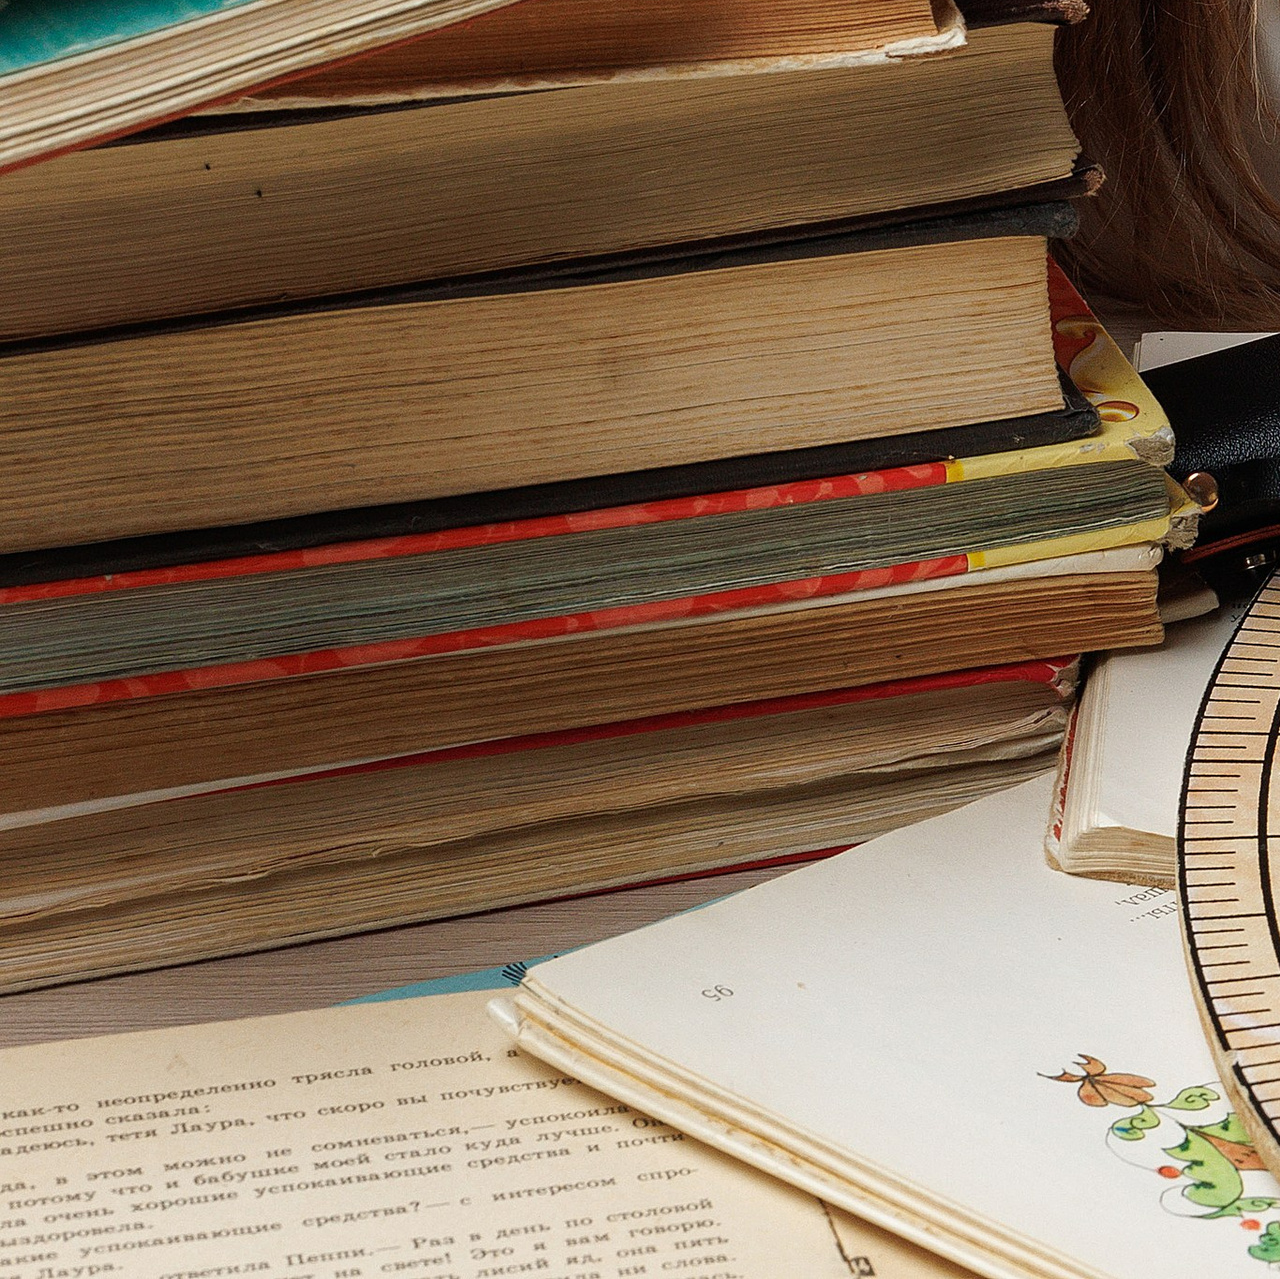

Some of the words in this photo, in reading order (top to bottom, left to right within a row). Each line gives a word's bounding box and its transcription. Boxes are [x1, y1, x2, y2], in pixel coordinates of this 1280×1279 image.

[701, 984, 734, 1002] 95
[2, 1102, 80, 1121] как-то
[97, 1078, 277, 1109] неопределенно
[291, 1066, 373, 1086] трясла
[390, 1050, 492, 1073] головой,
[507, 1048, 520, 1058] а
[104, 1103, 211, 1125] сказала:
[105, 1128, 158, 1143] тетя
[266, 1109, 306, 1123] что
[317, 1100, 385, 1118] скоро
[397, 1094, 427, 1106] вы
[8, 1189, 97, 1210] потому
[111, 1183, 153, 1196] что
[193, 1166, 300, 1187] бабушке
[314, 1152, 371, 1171] моей
[384, 1145, 452, 1161] стало
[465, 1135, 521, 1152] куда
[44, 1207, 115, 1224] очень
[131, 1192, 239, 1213] хорошие
[253, 1162, 452, 1198] успокаивающие
[467, 1146, 571, 1169] средства
[617, 1131, 686, 1149] почти
[87, 1166, 143, 1182] этом
[163, 1152, 247, 1172] можно
[266, 1147, 292, 1159] не
[505, 1104, 631, 1130] успокоила
[79, 1221, 283, 1258] успокаивающие
[493, 1174, 617, 1202] интересом
[606, 1197, 714, 1224] столовой
